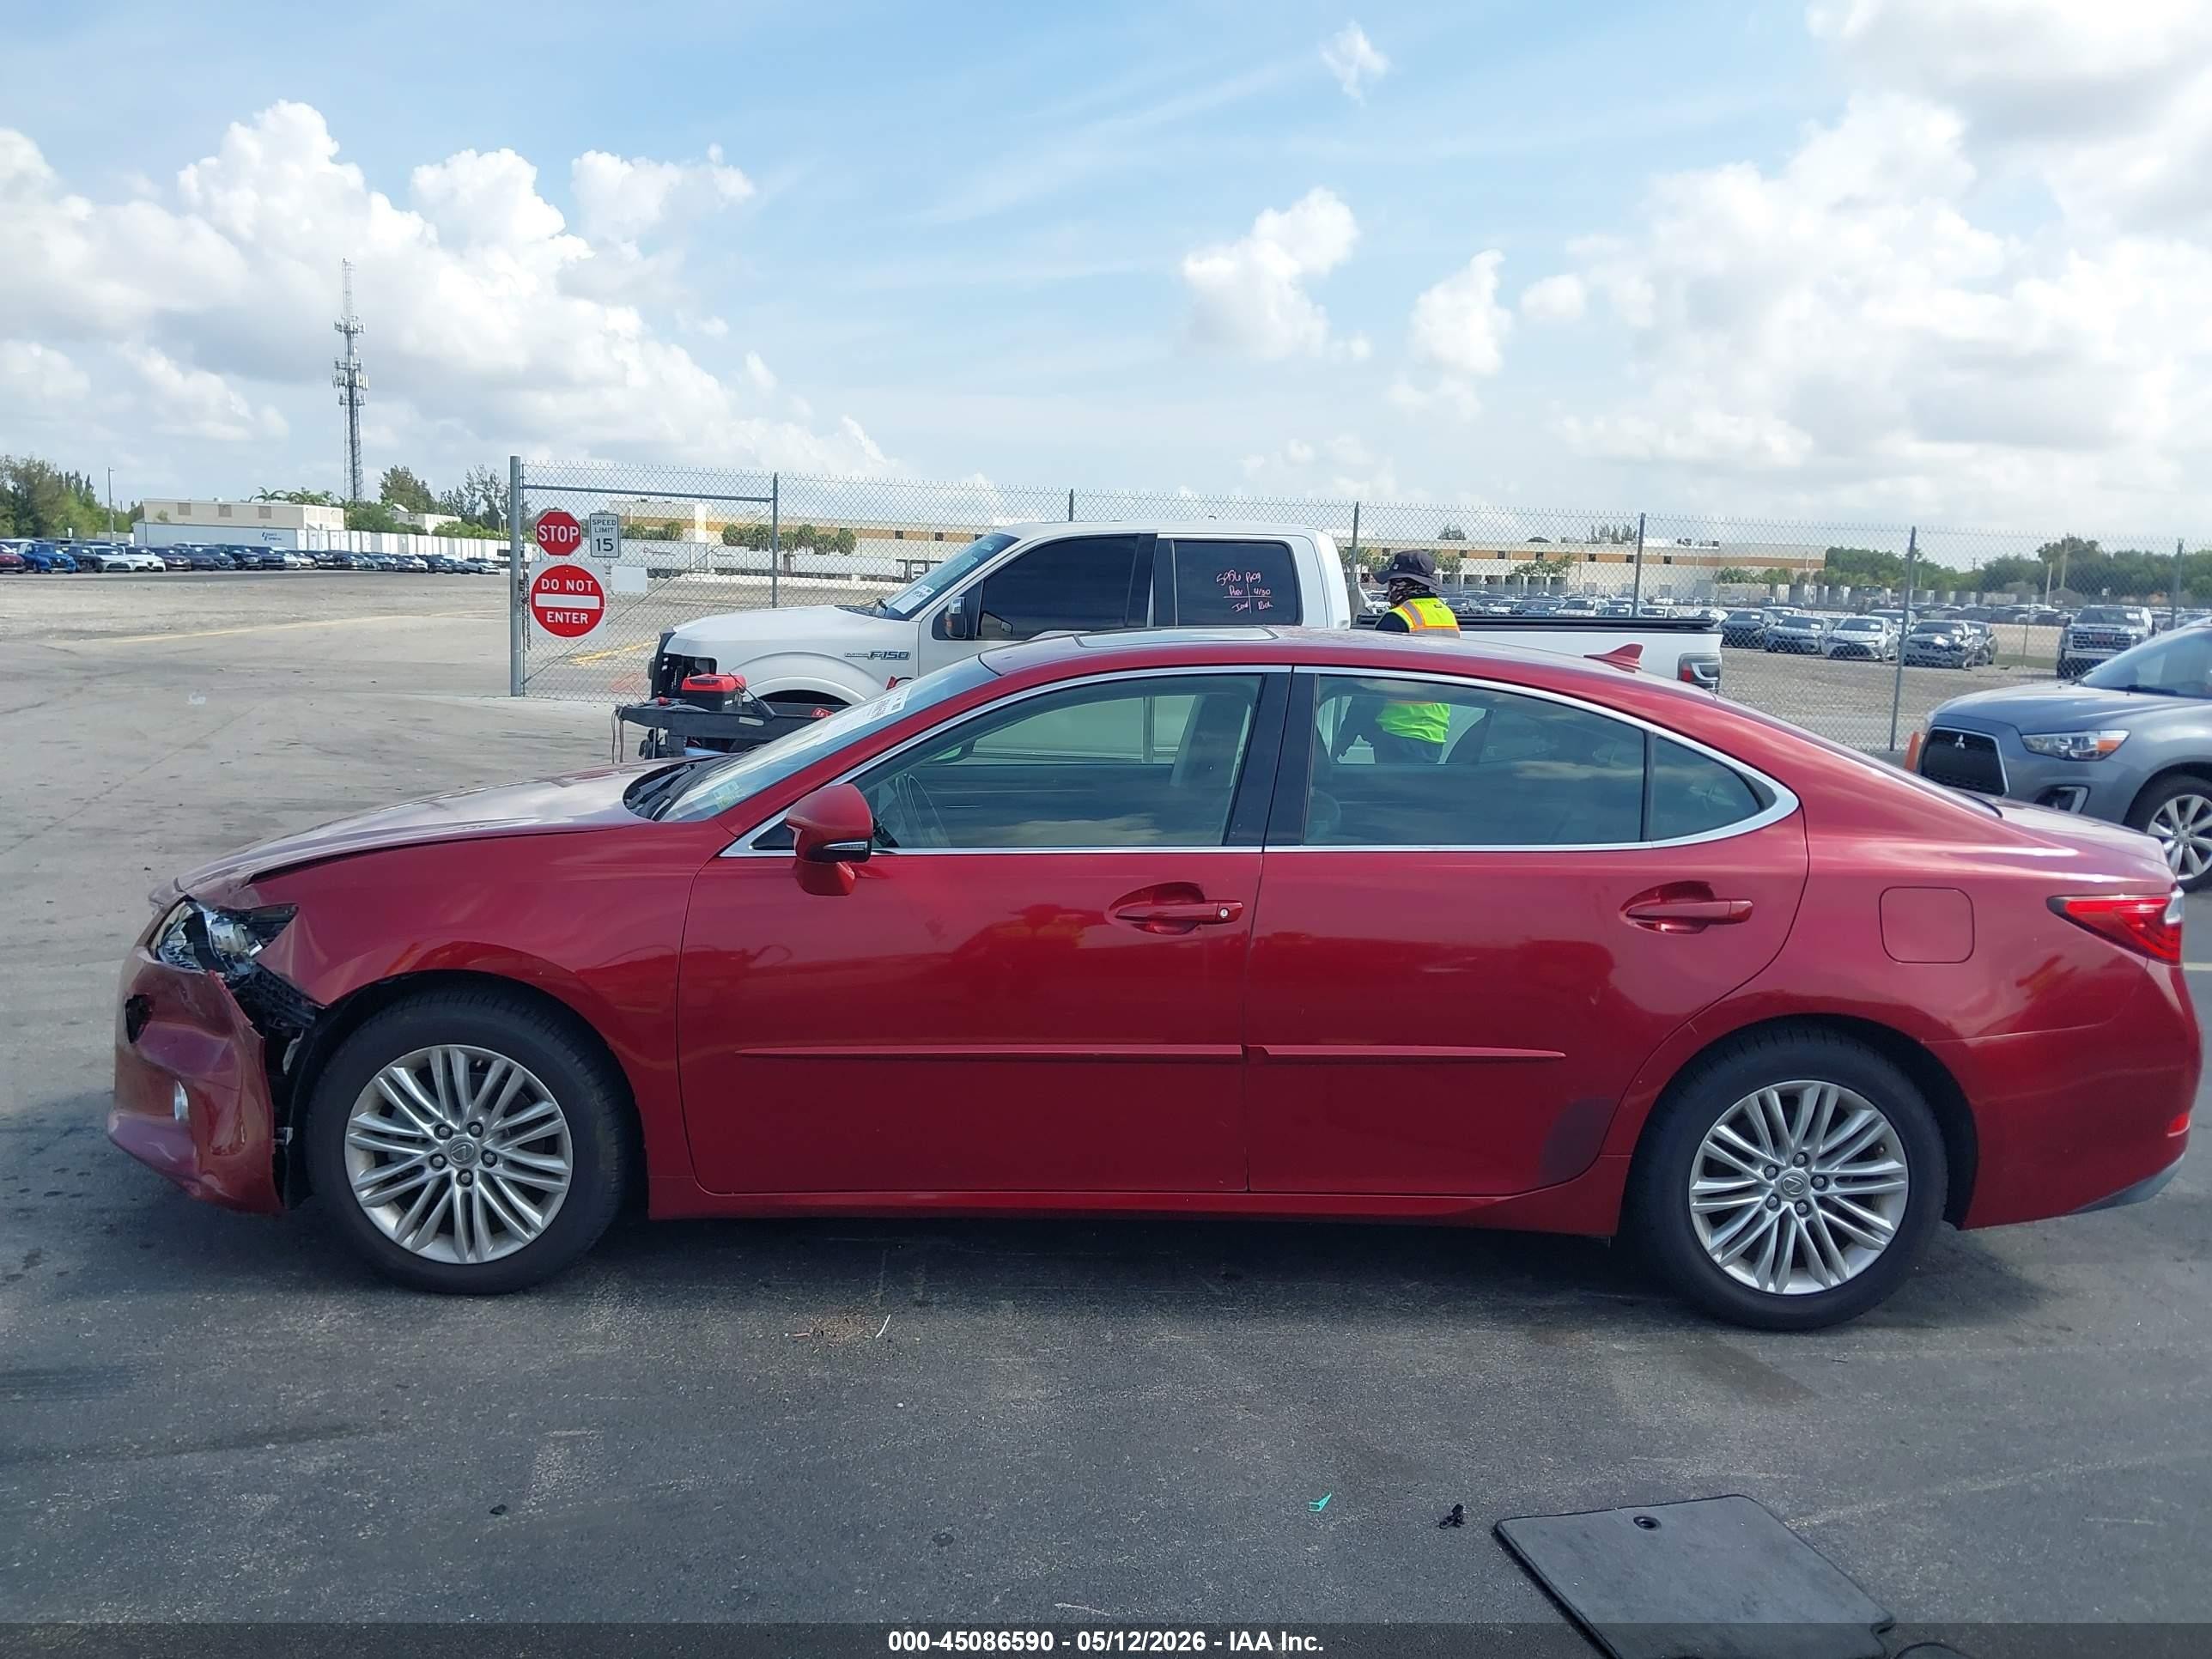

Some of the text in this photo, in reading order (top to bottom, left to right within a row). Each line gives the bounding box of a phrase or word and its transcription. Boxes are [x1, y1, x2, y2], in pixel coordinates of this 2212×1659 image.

[538, 525, 580, 544] STOP
[595, 538, 614, 552] 15
[541, 578, 594, 592] DO NOT
[546, 611, 588, 625] ENTER
